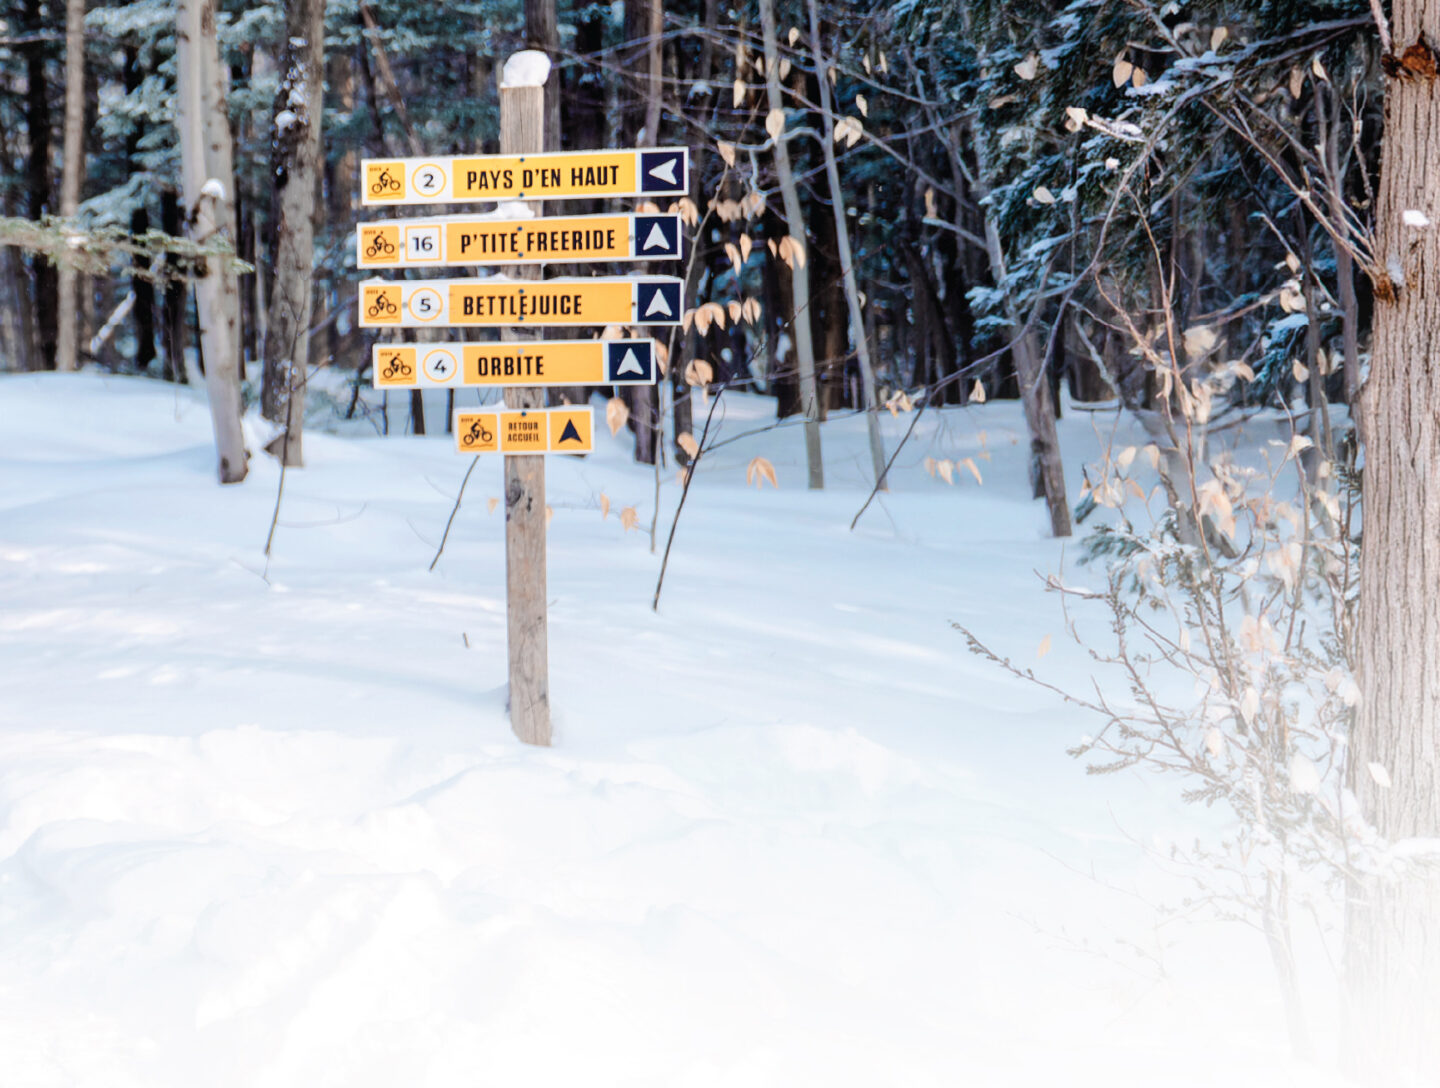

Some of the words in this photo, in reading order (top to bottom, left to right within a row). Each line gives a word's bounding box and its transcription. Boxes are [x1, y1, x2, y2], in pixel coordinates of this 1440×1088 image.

[422, 173, 435, 188] 2
[467, 169, 513, 190] PAYS
[523, 167, 561, 188] D'EN
[571, 165, 620, 187] HAUT
[412, 236, 433, 251] 16
[460, 232, 519, 254] P'TITE
[527, 229, 616, 251] FREERIDE
[420, 298, 431, 312] 5
[463, 295, 582, 316] BETTLEJUICE
[433, 358, 447, 373] 4
[477, 355, 545, 377] ORBITE
[508, 422, 539, 431] RETOUR
[507, 433, 540, 442] ACCUEIL
